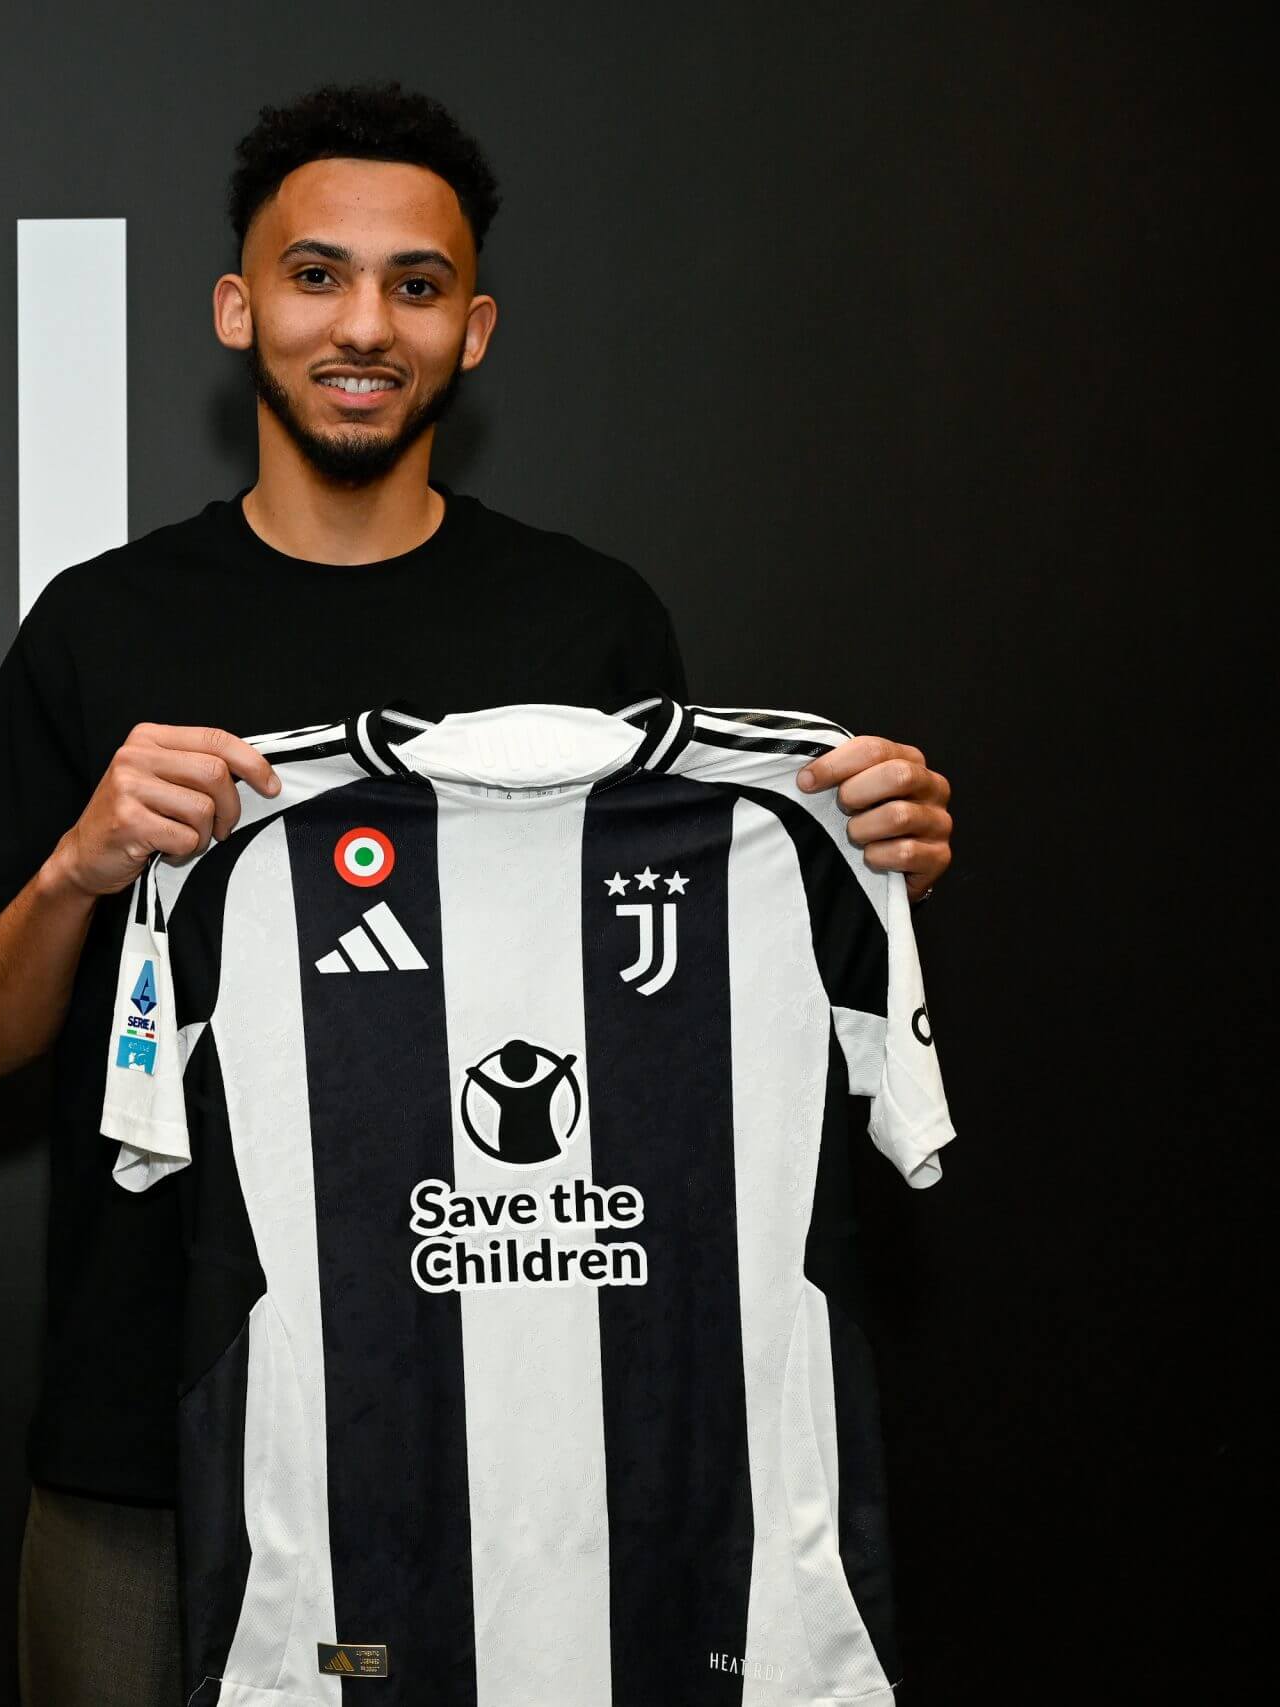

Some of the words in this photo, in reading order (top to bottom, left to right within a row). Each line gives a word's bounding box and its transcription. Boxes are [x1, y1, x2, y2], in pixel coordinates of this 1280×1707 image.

[127, 1016, 150, 1031] SERIE
[415, 1185, 538, 1230] Save
[550, 1180, 638, 1223] the
[416, 1238, 641, 1287] Children
